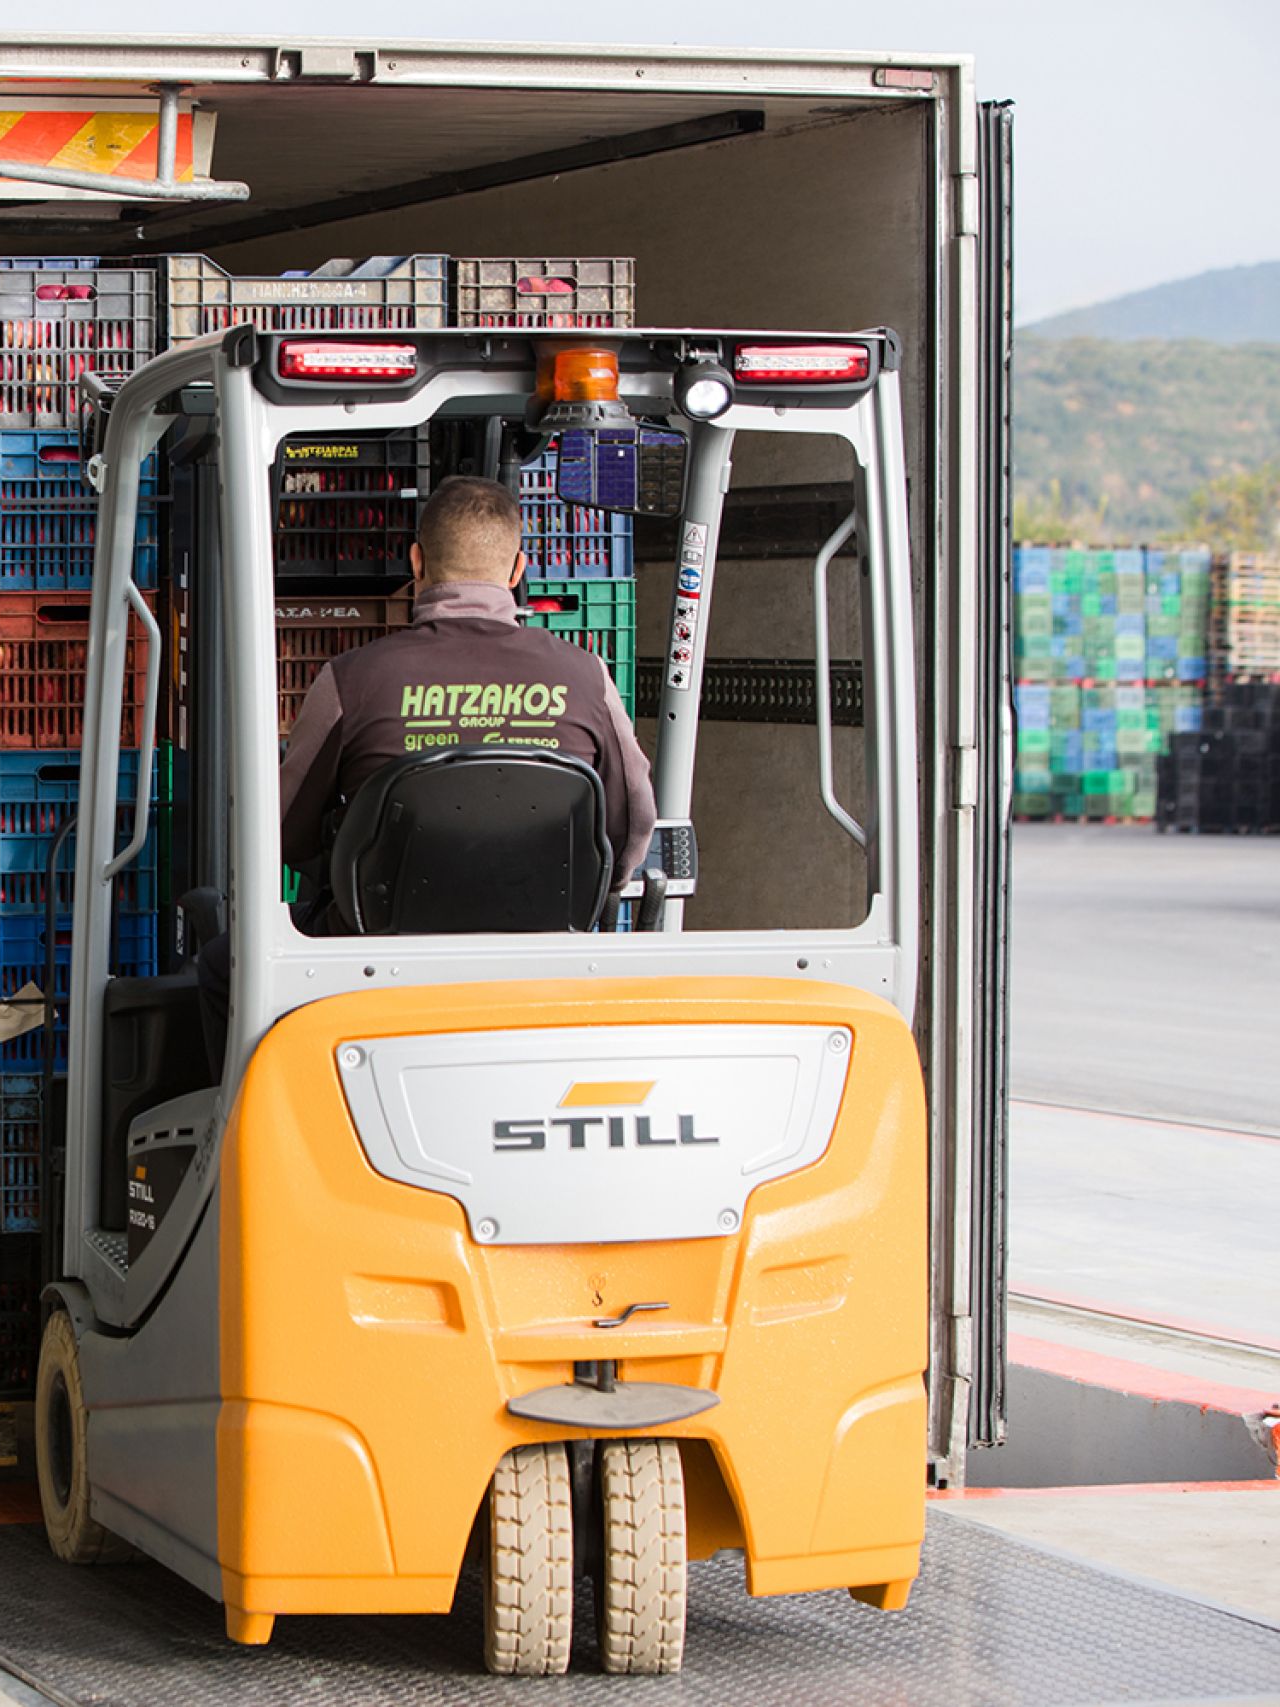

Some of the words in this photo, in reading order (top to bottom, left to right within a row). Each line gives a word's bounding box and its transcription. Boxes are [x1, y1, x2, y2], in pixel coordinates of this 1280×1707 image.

[400, 683, 568, 718] HATZAKOS
[459, 716, 505, 728] GROUP
[404, 732, 459, 752] green
[493, 1114, 719, 1151] STILL
[129, 1180, 154, 1203] STILL
